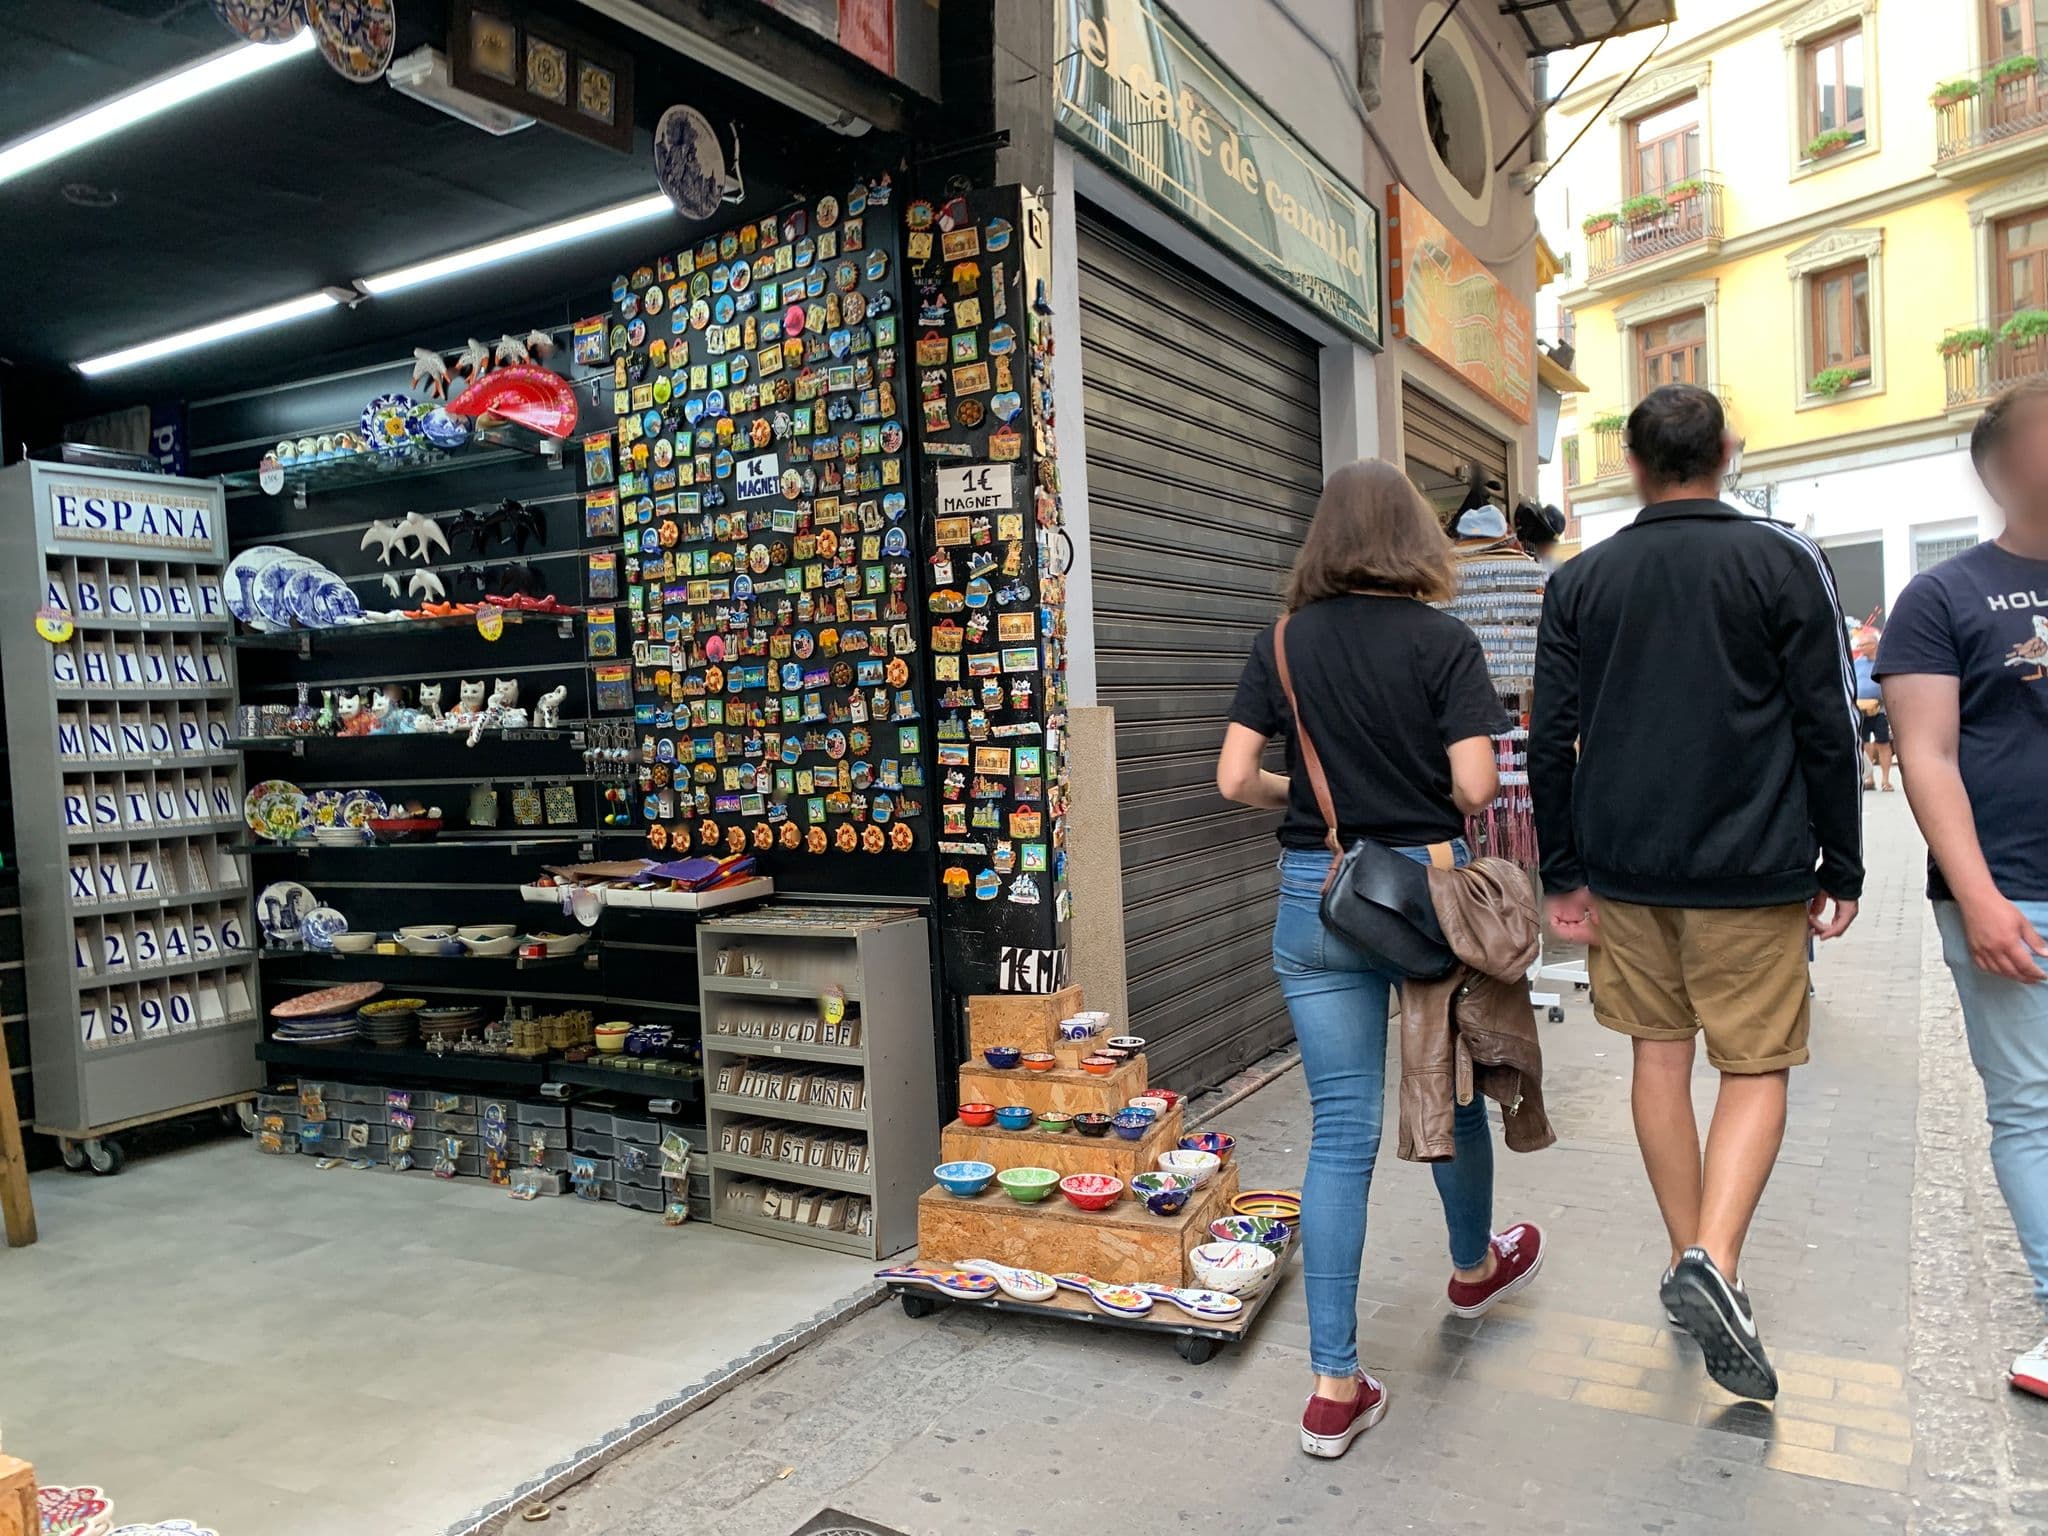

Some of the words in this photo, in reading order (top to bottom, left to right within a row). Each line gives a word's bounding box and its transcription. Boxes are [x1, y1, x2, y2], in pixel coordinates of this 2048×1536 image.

[1078, 17, 1122, 81] el
[1220, 130, 1258, 194] de
[1265, 179, 1363, 278] camilo
[747, 459, 764, 477] 1€
[961, 468, 993, 493] 1€
[737, 475, 779, 499] MAGNET
[944, 494, 1002, 512] MAGNET
[48, 582, 68, 610] A
[78, 582, 100, 612] B
[109, 586, 132, 613] C
[140, 586, 162, 614] D
[168, 586, 190, 614] E
[198, 586, 218, 614] F
[54, 653, 74, 682] G
[84, 653, 108, 682] H
[118, 654, 134, 682] I
[146, 655, 162, 682] J
[174, 655, 196, 682] K
[202, 655, 222, 682] L
[58, 724, 81, 754] M
[179, 722, 196, 750] P
[64, 796, 88, 825] R
[95, 794, 116, 824] S
[126, 794, 144, 822] T
[156, 790, 174, 820] U
[184, 788, 200, 817] V
[212, 786, 230, 814] W
[70, 866, 94, 897] X
[100, 864, 118, 894] Y
[130, 862, 154, 890] Z
[104, 936, 124, 964] 2
[135, 931, 156, 960] 3
[166, 928, 186, 956] 4
[193, 926, 212, 952] 5
[221, 919, 240, 949] 6
[1001, 948, 1032, 992] 1€
[80, 1010, 95, 1040] 7
[110, 1004, 128, 1034] 8
[140, 1000, 160, 1029] 9
[771, 1022, 781, 1036] B
[788, 1024, 798, 1038] C
[804, 1025, 814, 1040] D
[825, 1025, 835, 1042] E
[841, 1027, 851, 1044] F
[718, 1074, 729, 1091] H
[742, 1077, 750, 1093] I
[755, 1079, 764, 1096] J
[768, 1082, 780, 1099] K
[788, 1084, 798, 1101] L
[810, 1084, 823, 1102] M
[722, 1134, 731, 1150] P
[740, 1138, 750, 1154] Q
[762, 1139, 772, 1155] R
[782, 1141, 791, 1158] S
[794, 1146, 803, 1162] T
[811, 1148, 822, 1165] U
[833, 1149, 844, 1165] V
[848, 1154, 860, 1170] W
